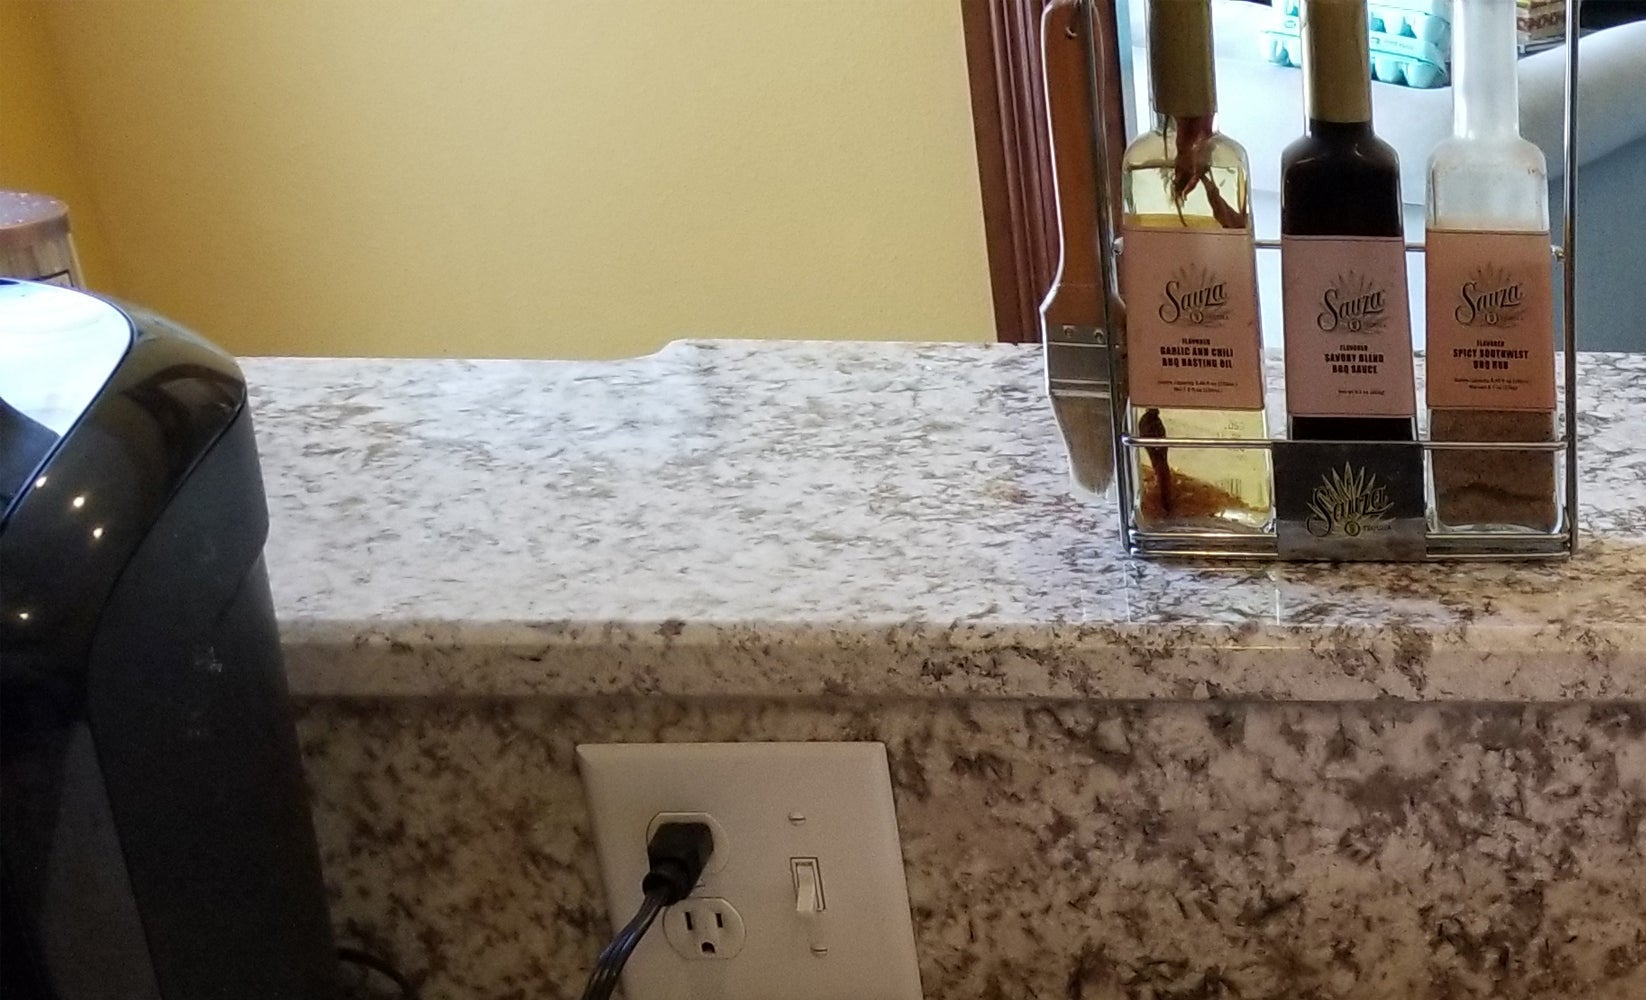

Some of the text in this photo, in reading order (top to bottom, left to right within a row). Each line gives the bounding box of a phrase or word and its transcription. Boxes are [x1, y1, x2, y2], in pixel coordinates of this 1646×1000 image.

[1159, 280, 1227, 323] Sauza
[1455, 281, 1522, 326] Sauza
[1317, 288, 1386, 332] Sauza
[1160, 346, 1234, 357] GARLIC AND CHILI
[1453, 348, 1529, 359] SPICY SOUTHWEST
[1181, 358, 1218, 368] BASTING
[1219, 359, 1233, 368] OIL
[1324, 353, 1384, 363] SAVORY BLEND
[1332, 364, 1378, 374] BBQ SAUCE
[1305, 486, 1389, 538] Sauza
